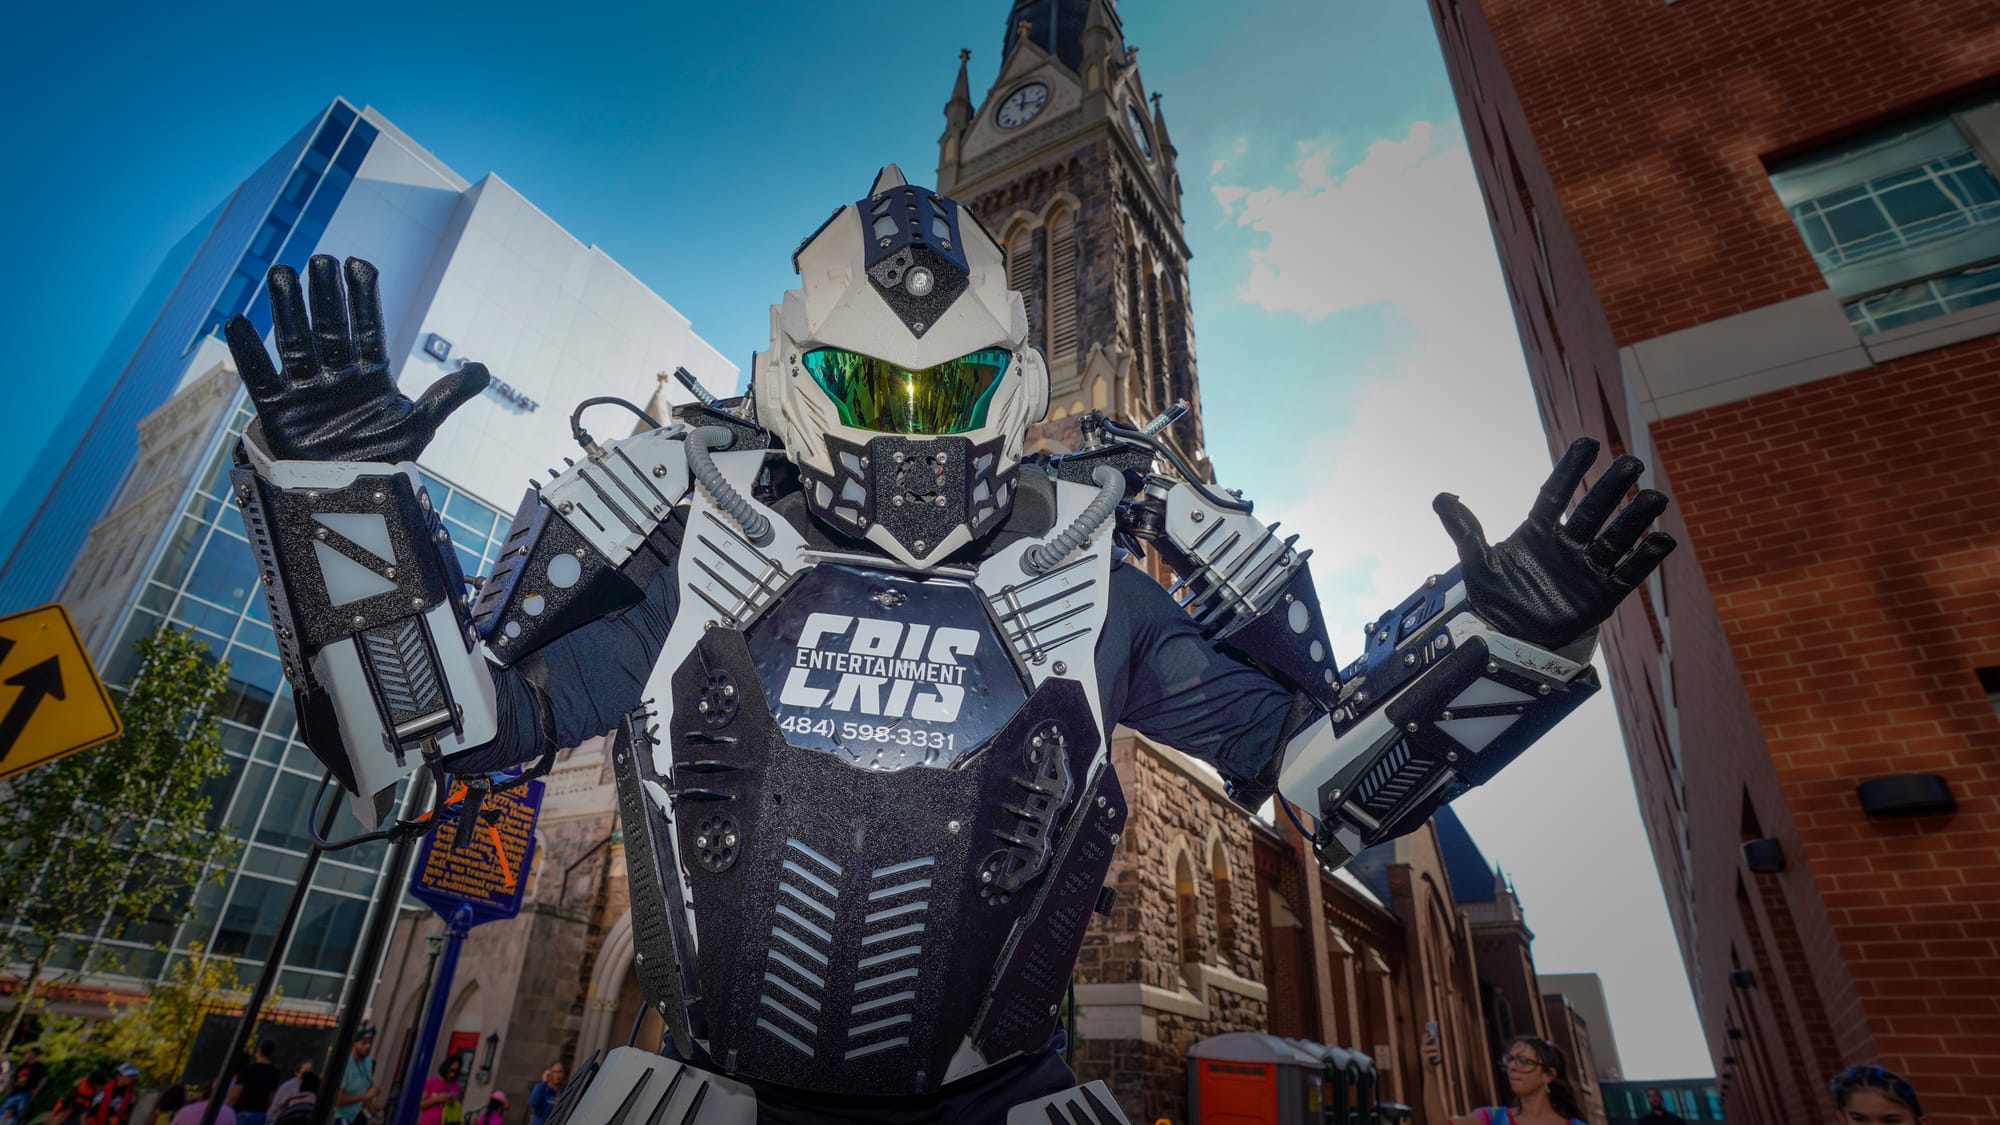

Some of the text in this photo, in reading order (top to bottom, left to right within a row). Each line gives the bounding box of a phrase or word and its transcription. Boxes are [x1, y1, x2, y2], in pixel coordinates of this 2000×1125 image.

[780, 612, 980, 722] CRIS
[796, 649, 966, 684] ENTERTAINMENT
[775, 713, 954, 750] (484) 598-3331
